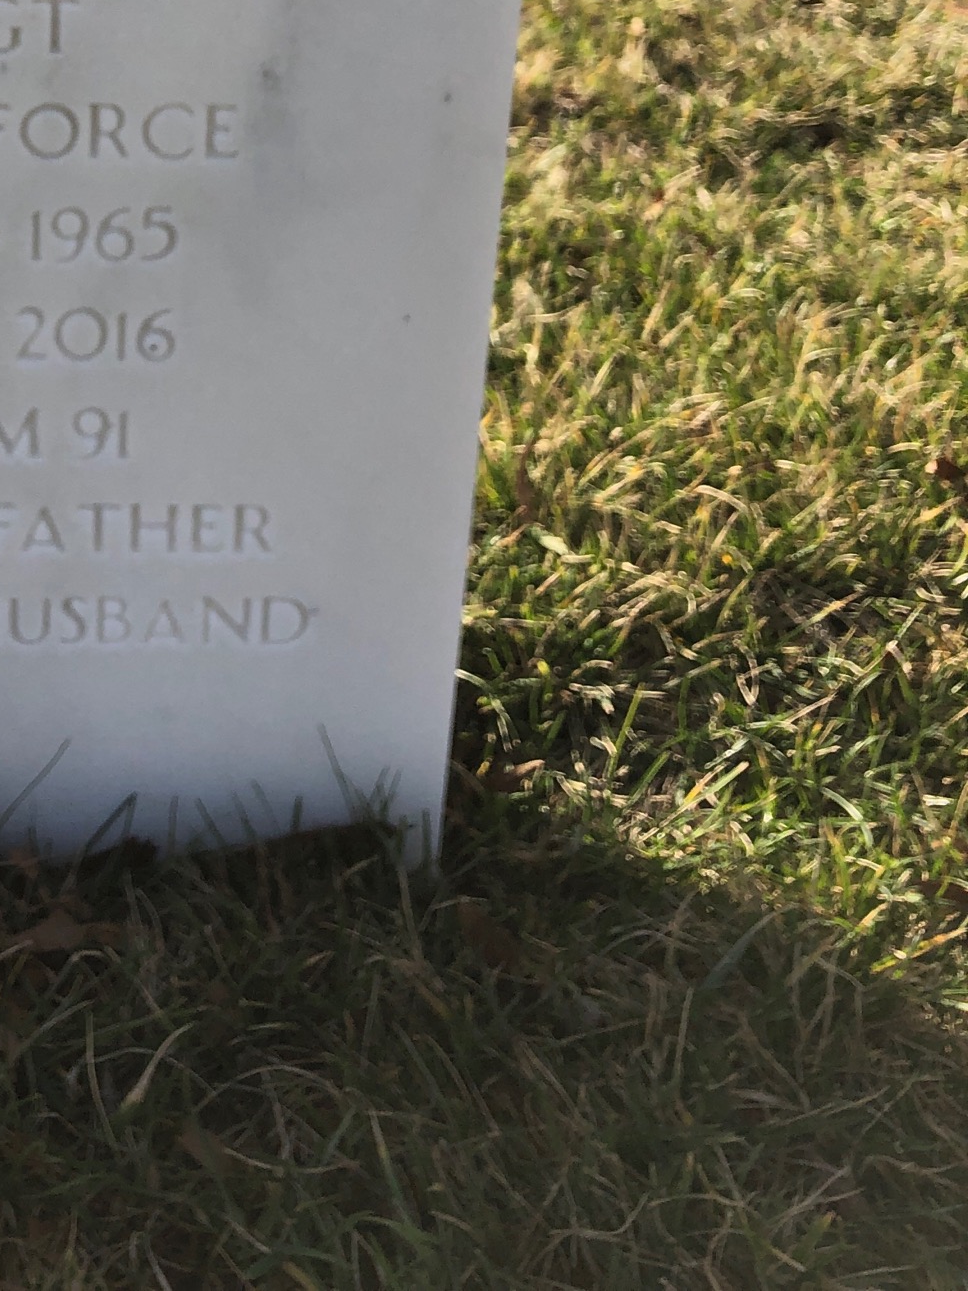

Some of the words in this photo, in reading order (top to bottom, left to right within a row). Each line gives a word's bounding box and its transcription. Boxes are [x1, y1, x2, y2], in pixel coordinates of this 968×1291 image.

[31, 206, 180, 263] 1965
[15, 306, 177, 363] 2016
[71, 406, 130, 460] 91
